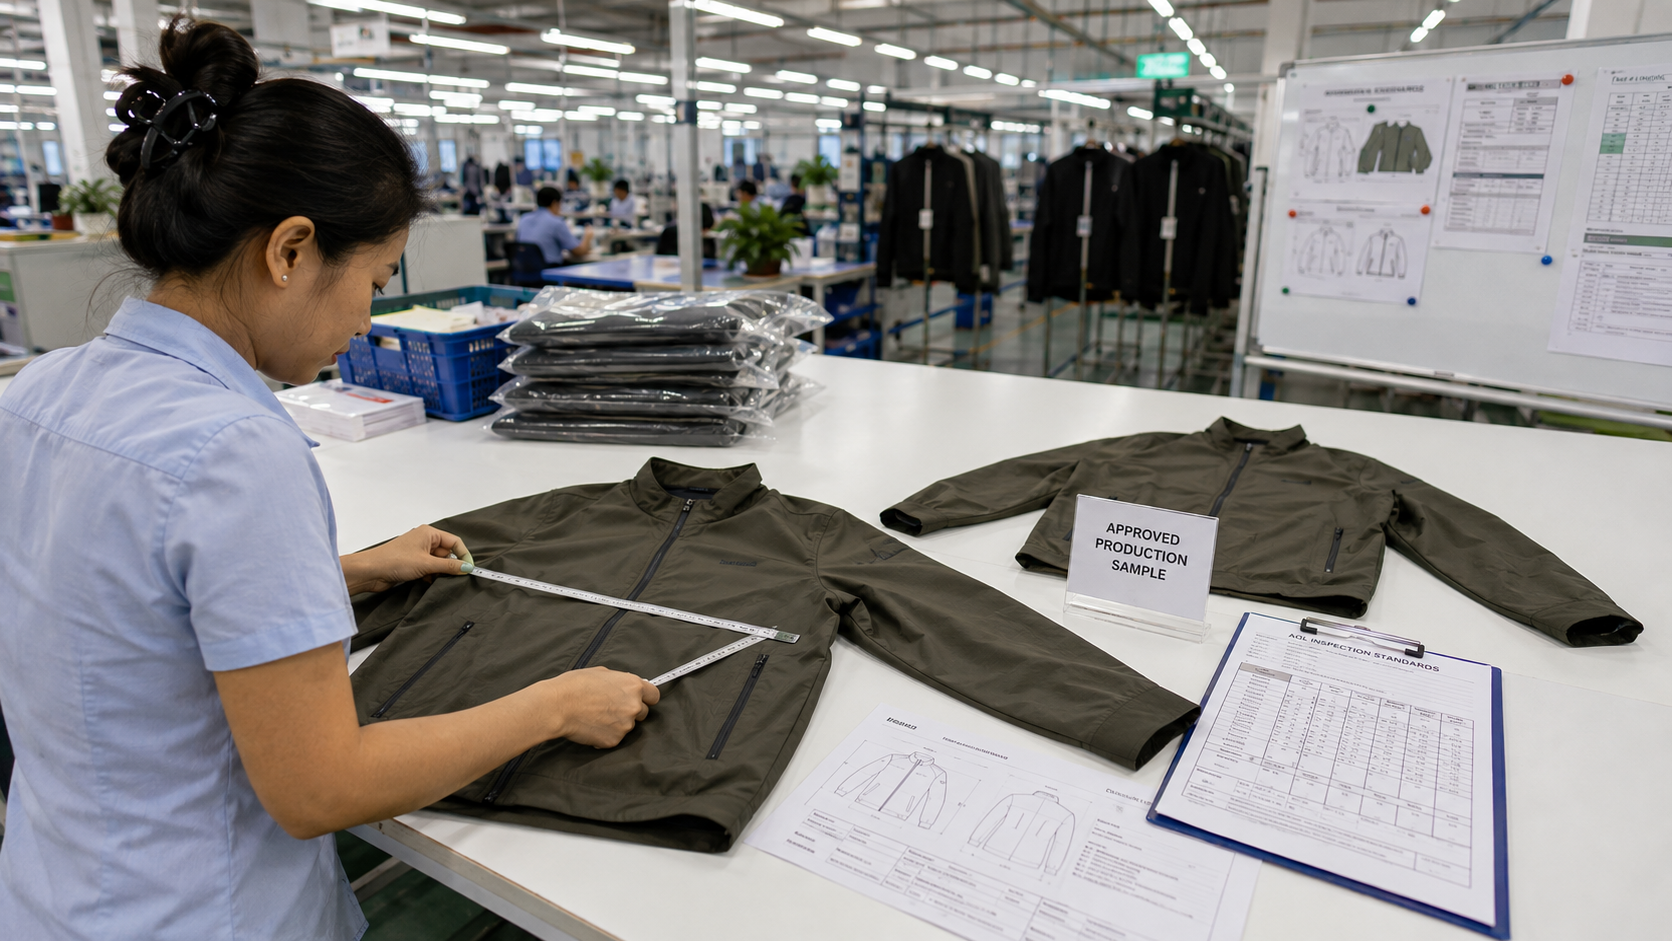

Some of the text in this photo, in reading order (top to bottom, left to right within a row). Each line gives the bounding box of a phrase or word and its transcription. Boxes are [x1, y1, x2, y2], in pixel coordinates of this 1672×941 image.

[1106, 522, 1180, 546] APPROVED
[1095, 538, 1188, 566] PRODUCTION
[1112, 560, 1167, 580] SAMPLE
[1310, 638, 1372, 656] INSPECTION
[1374, 652, 1440, 672] STANDARDS
